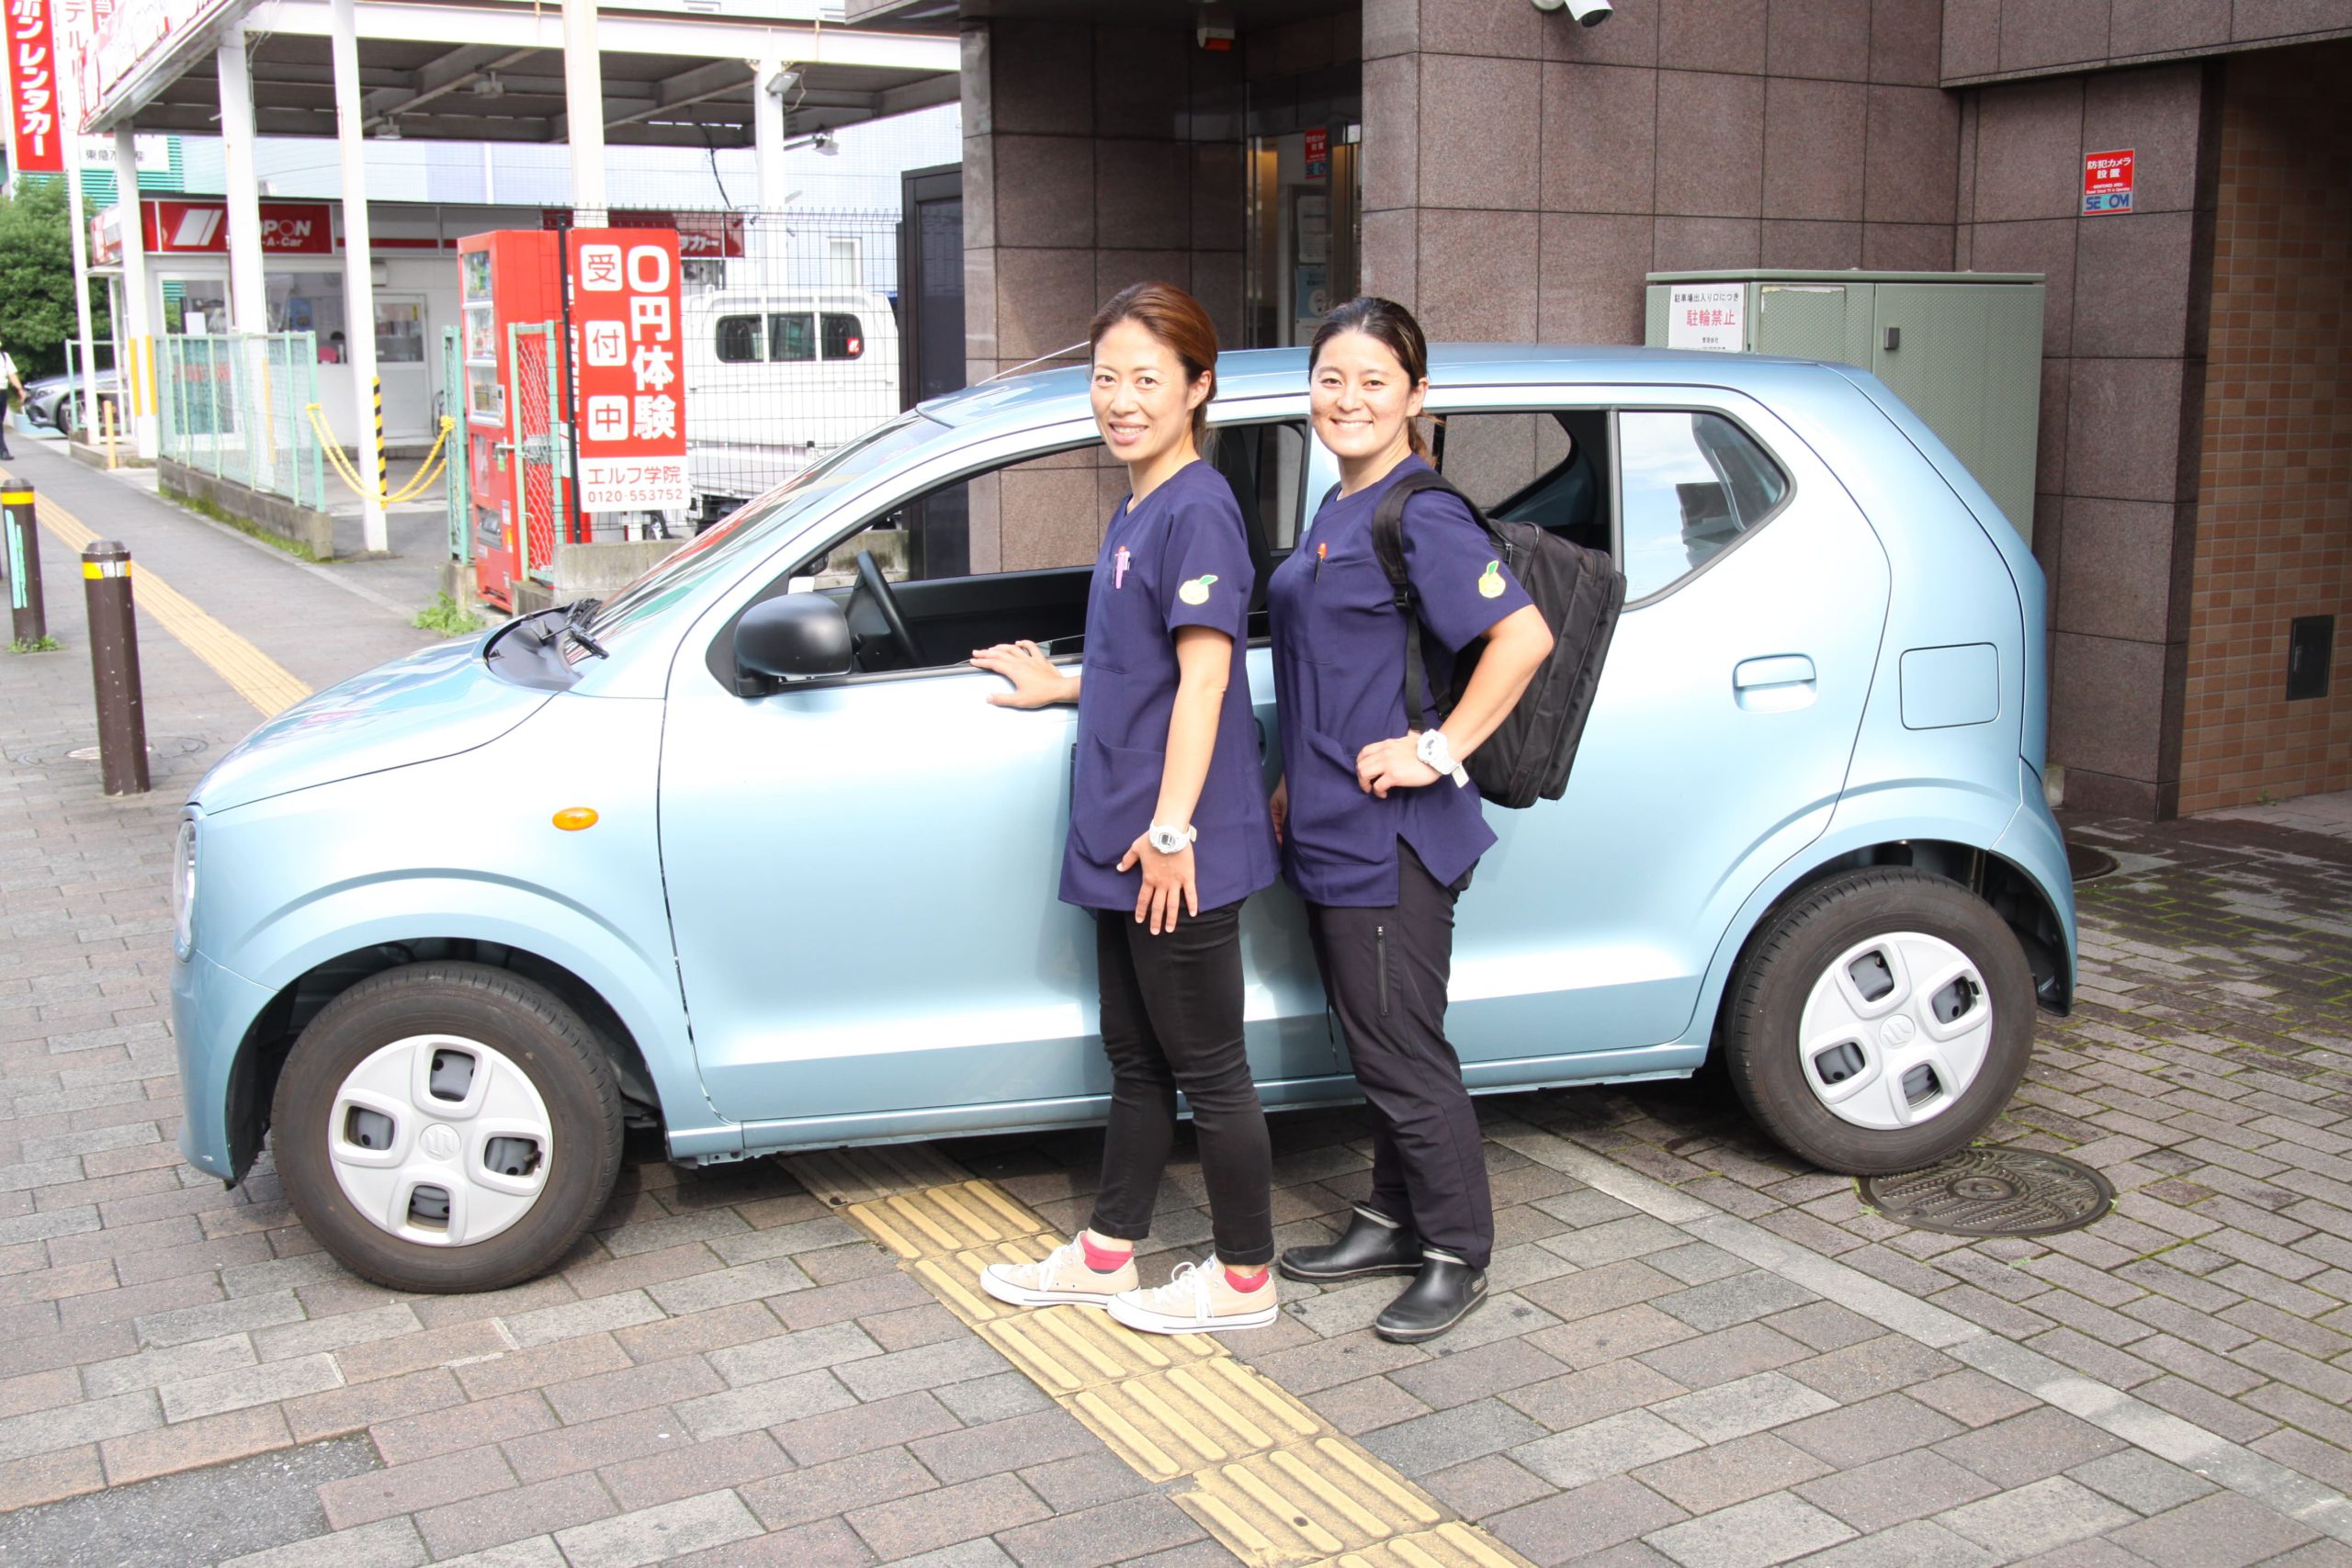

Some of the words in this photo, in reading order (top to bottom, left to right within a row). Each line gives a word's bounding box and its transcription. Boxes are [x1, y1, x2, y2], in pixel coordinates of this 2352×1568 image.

[2086, 157, 2132, 170] 防犯カメラ
[1674, 292, 1739, 302] 駐車場出入り口につき
[1687, 309, 1736, 326] 駐輪禁止
[588, 466, 682, 485] エルフ学院
